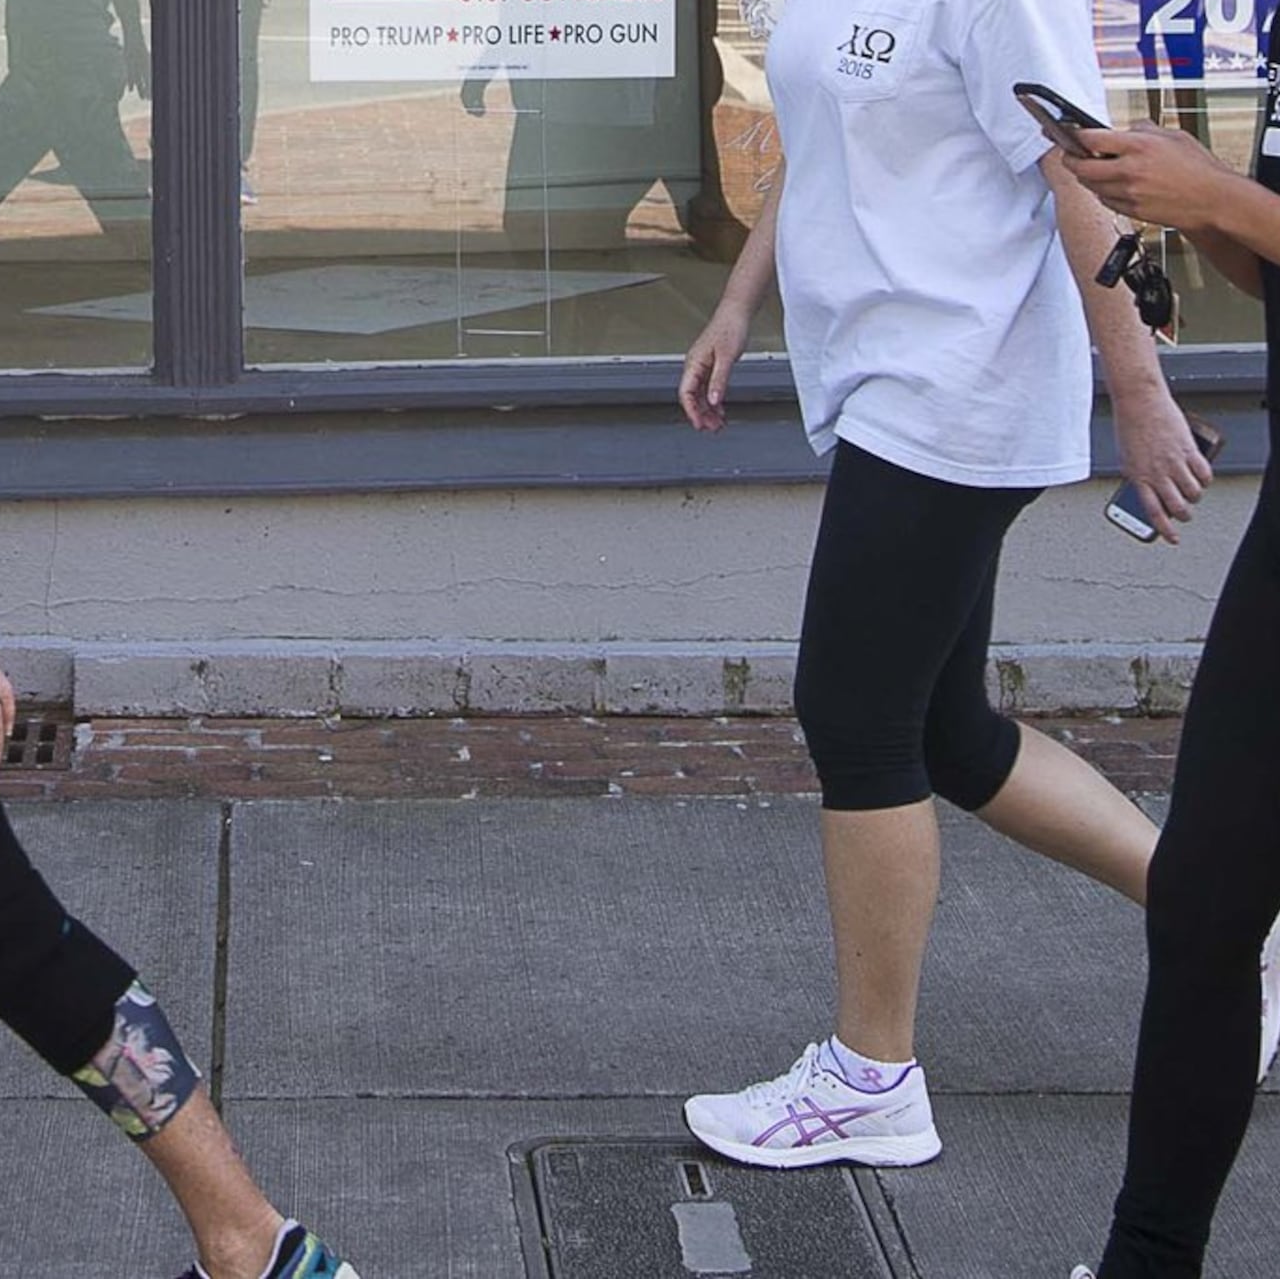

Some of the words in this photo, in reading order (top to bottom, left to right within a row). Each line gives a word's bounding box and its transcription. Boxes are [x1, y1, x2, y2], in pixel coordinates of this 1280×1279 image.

[331, 26, 370, 46] PRO
[377, 25, 443, 45] TRUMP
[463, 25, 502, 45] PRO
[509, 24, 544, 44] LIFE
[564, 24, 602, 44] PRO
[610, 23, 658, 43] GUN
[837, 58, 875, 79] 2018
